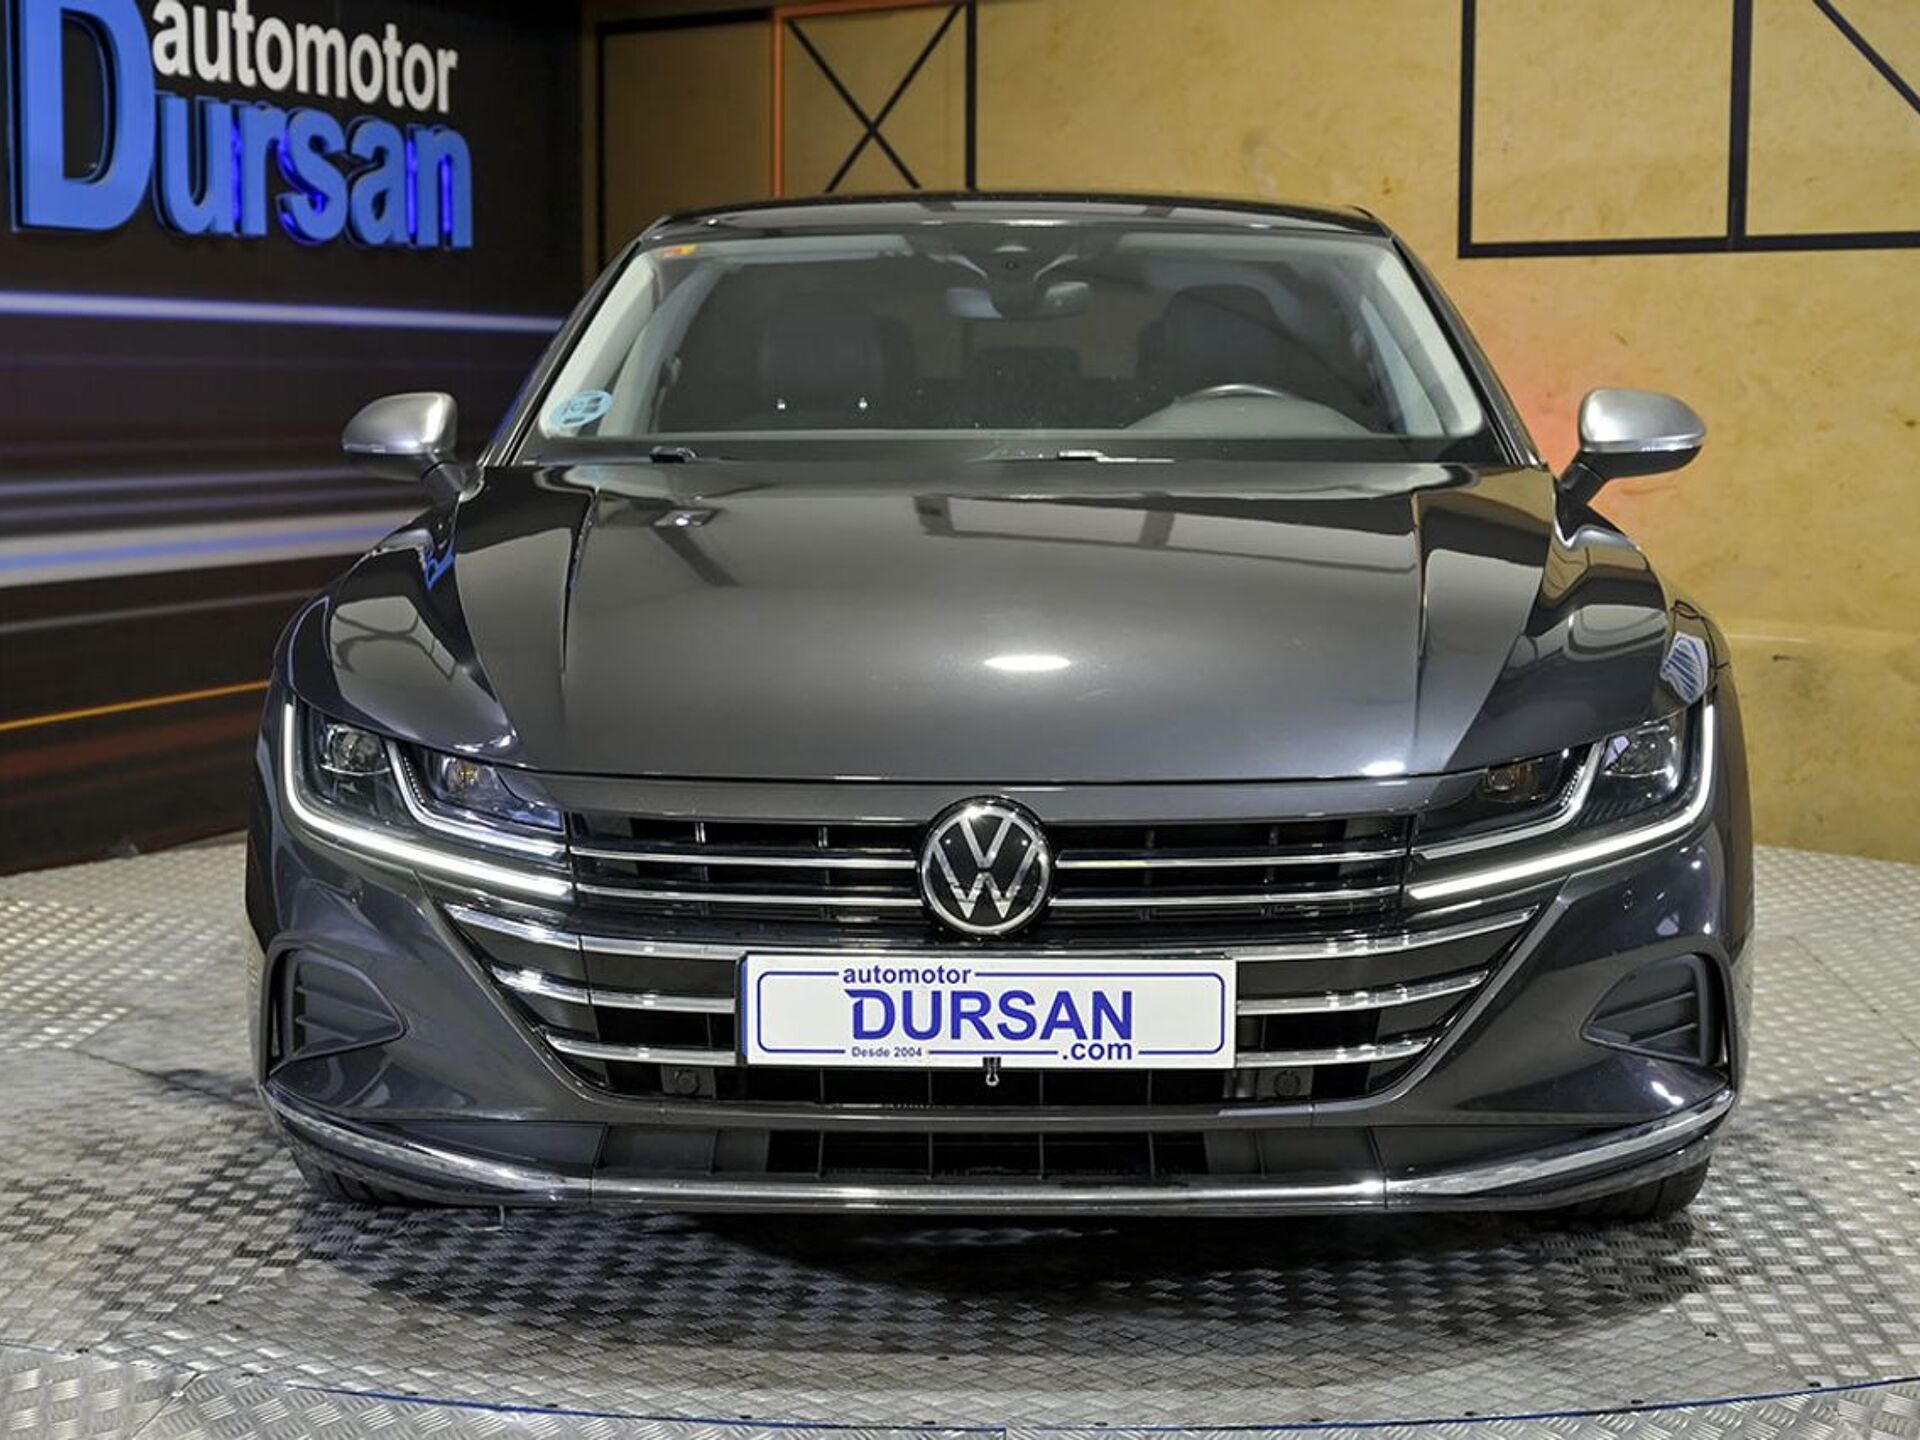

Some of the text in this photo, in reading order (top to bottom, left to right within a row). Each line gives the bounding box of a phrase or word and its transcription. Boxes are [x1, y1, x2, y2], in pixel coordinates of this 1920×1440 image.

[152, 0, 457, 113] automotor
[11, 0, 473, 249] Dursan
[842, 964, 972, 985] automotor
[843, 988, 1133, 1041] DURSAN
[851, 1045, 923, 1059] Desde 2004
[1062, 1042, 1133, 1061] .com
